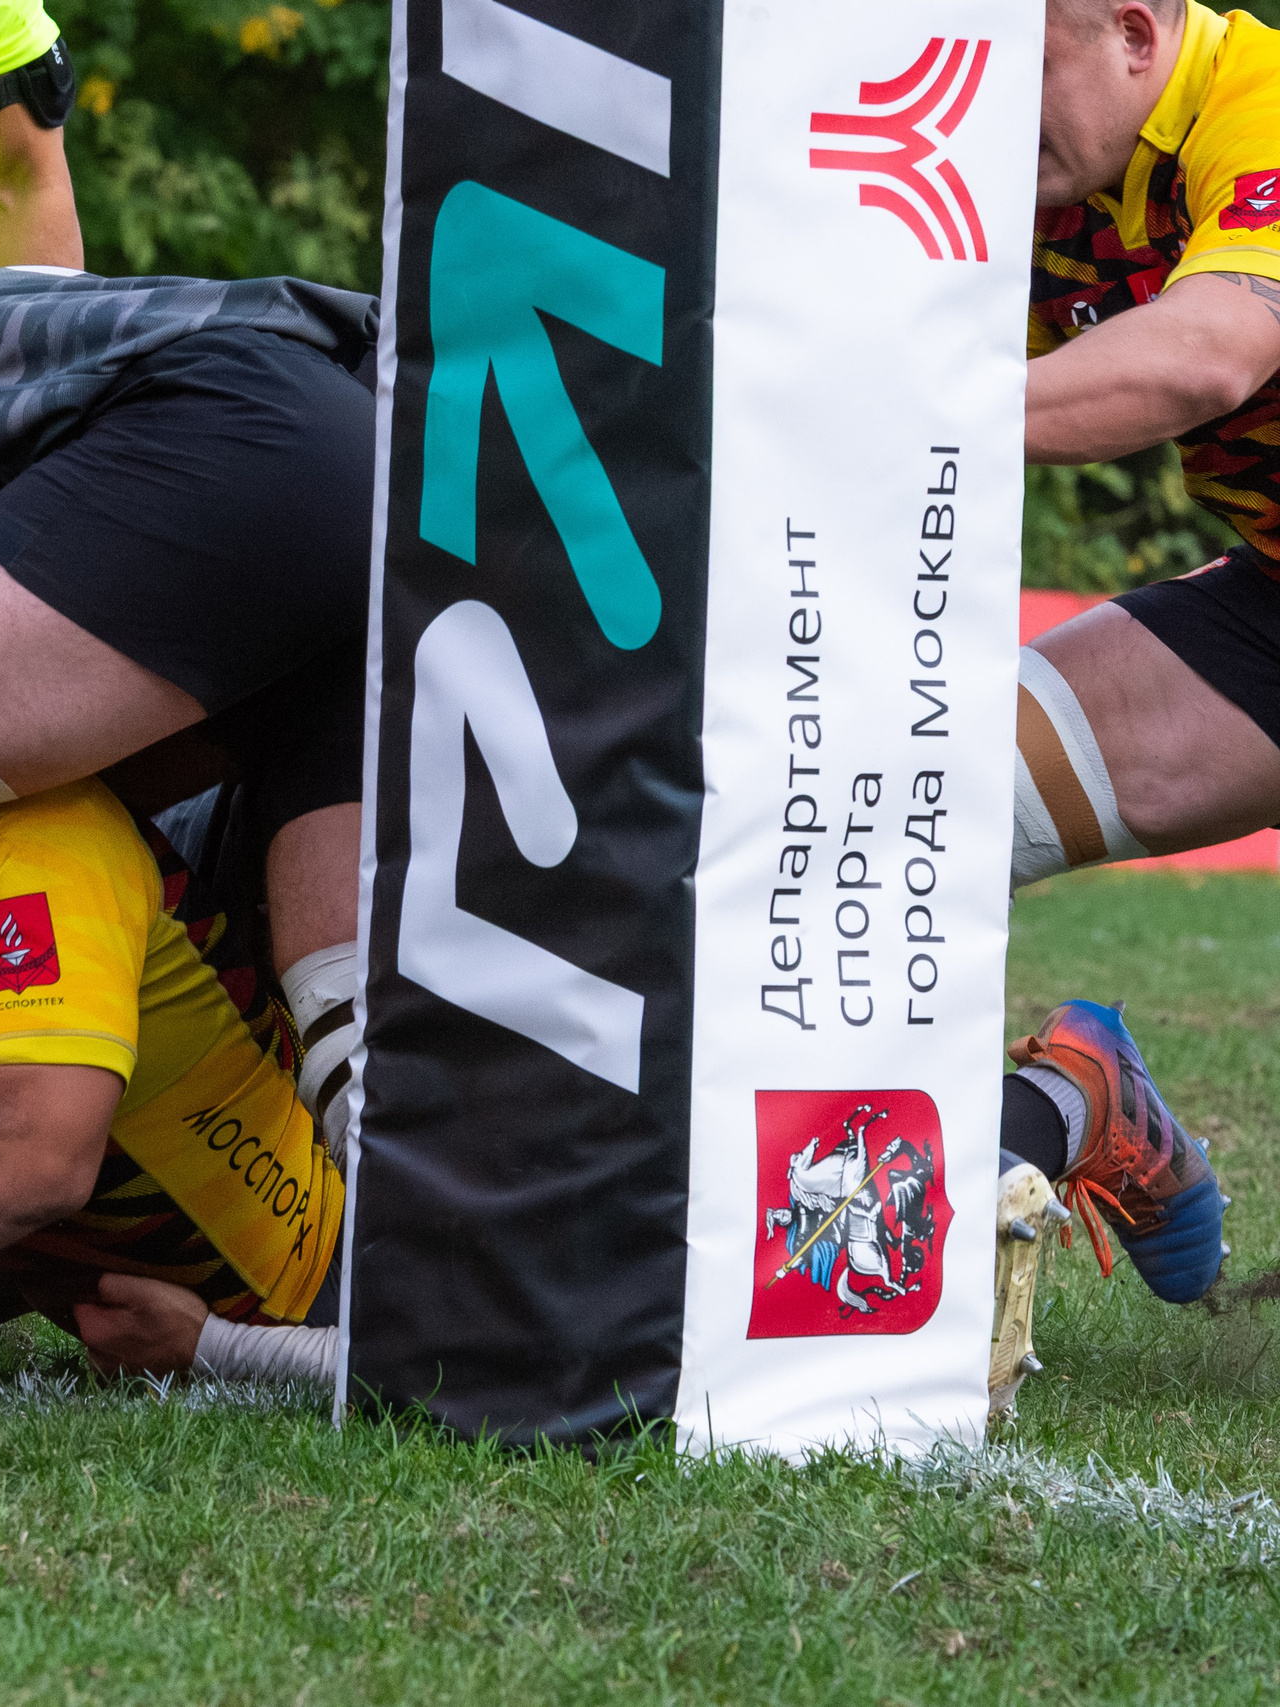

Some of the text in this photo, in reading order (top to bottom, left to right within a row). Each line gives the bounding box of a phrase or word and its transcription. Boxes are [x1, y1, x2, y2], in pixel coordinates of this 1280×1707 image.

[761, 517, 828, 1030] Департамент
[835, 772, 883, 1027] спорта
[904, 446, 960, 1025] города Москвы
